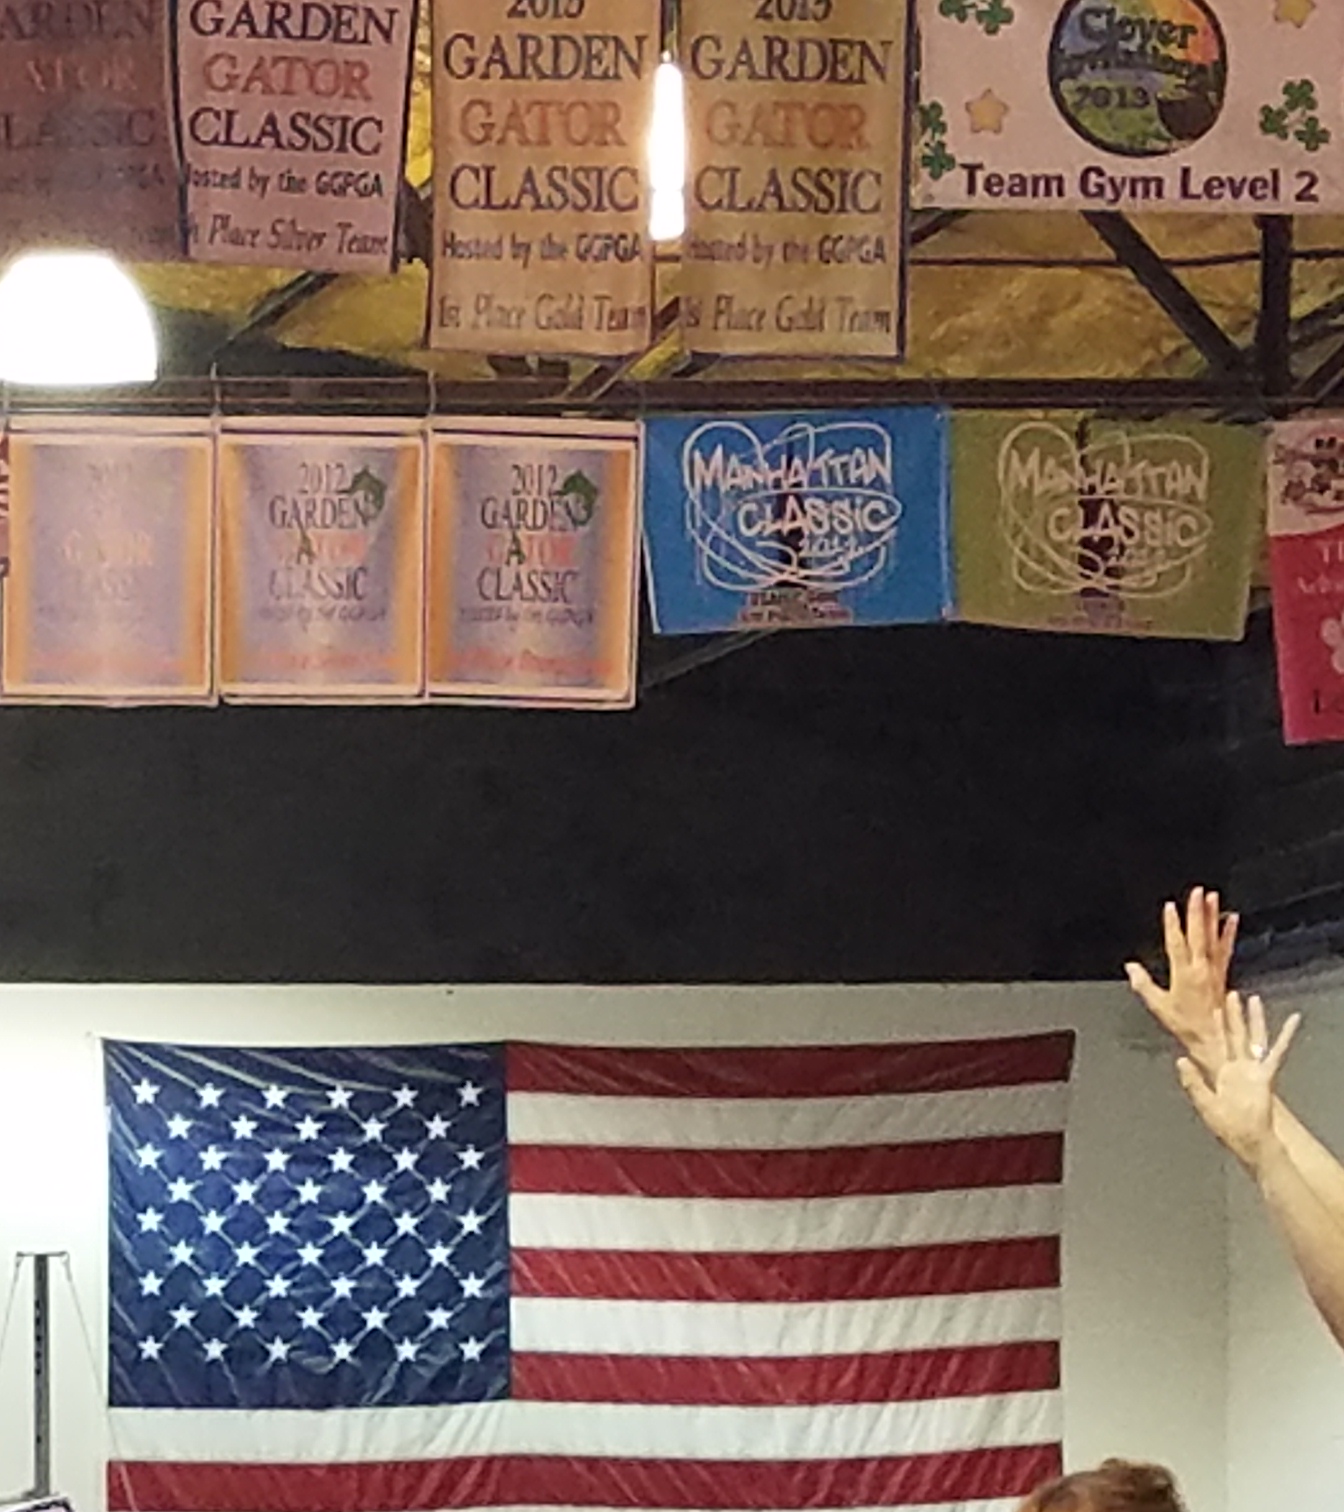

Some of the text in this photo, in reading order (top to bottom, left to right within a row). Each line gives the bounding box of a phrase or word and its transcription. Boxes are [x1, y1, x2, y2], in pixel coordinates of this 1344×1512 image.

[190, 0, 398, 46] GARDEN
[1078, 7, 1199, 50] Clover
[203, 52, 372, 101] GATOR
[443, 32, 648, 81] GARDEN
[690, 35, 893, 85] GARDEN
[189, 107, 383, 156] CLASSIC
[461, 98, 626, 148] GATOR
[705, 100, 872, 150] GATOR
[249, 166, 307, 200] by the
[449, 163, 639, 214] CLASSIC
[694, 165, 883, 215] CLASSIC
[959, 162, 1319, 204] Team Gym Level 2
[208, 214, 261, 249] Place
[267, 218, 328, 251] Silver
[337, 221, 389, 256] Team
[442, 230, 568, 269] Hosted by the
[753, 234, 810, 271] by the
[534, 292, 585, 331] Gold
[593, 294, 647, 333] Team
[297, 462, 346, 494] 2012
[511, 463, 561, 497] 2012
[691, 443, 895, 492] MANHATTAN
[1009, 447, 1208, 501] MANHATTAN
[269, 495, 373, 530] GARDEN
[480, 496, 584, 533] GARDEN
[269, 566, 368, 601] CLASSIC
[476, 566, 578, 603] CLASSIC
